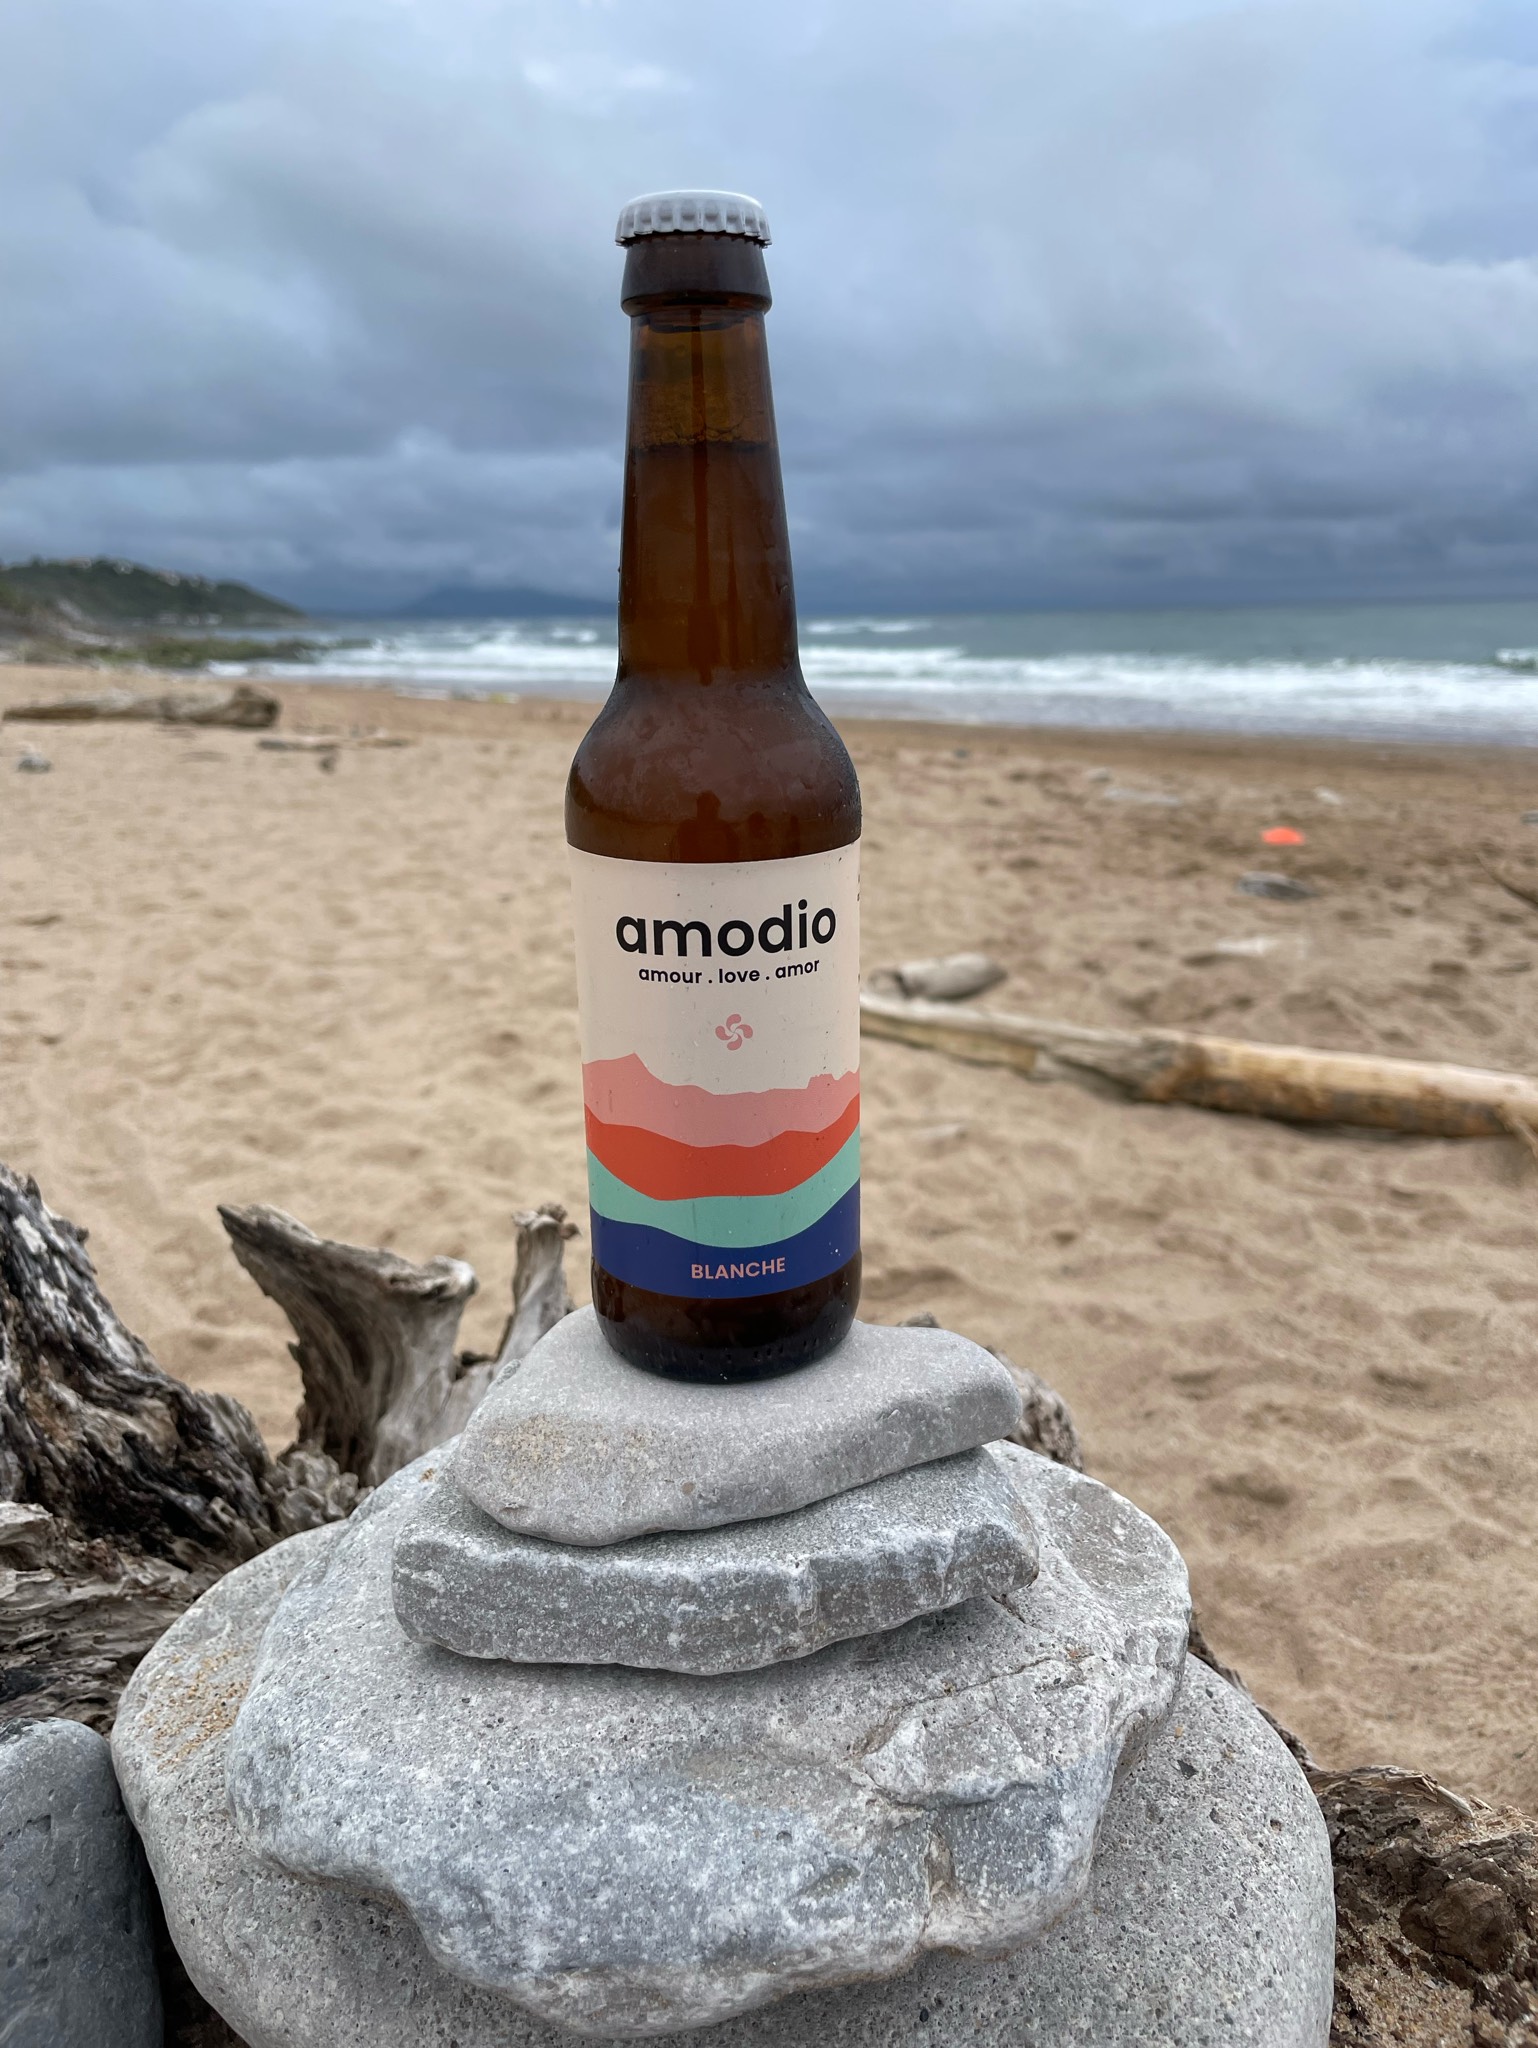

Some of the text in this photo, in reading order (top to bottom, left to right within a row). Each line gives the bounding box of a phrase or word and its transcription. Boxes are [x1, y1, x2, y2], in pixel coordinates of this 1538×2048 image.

[616, 899, 836, 957] amodio
[639, 967, 702, 984] amour
[719, 969, 760, 984] love
[775, 960, 820, 979] amor
[691, 1257, 786, 1280] BLANCHE
